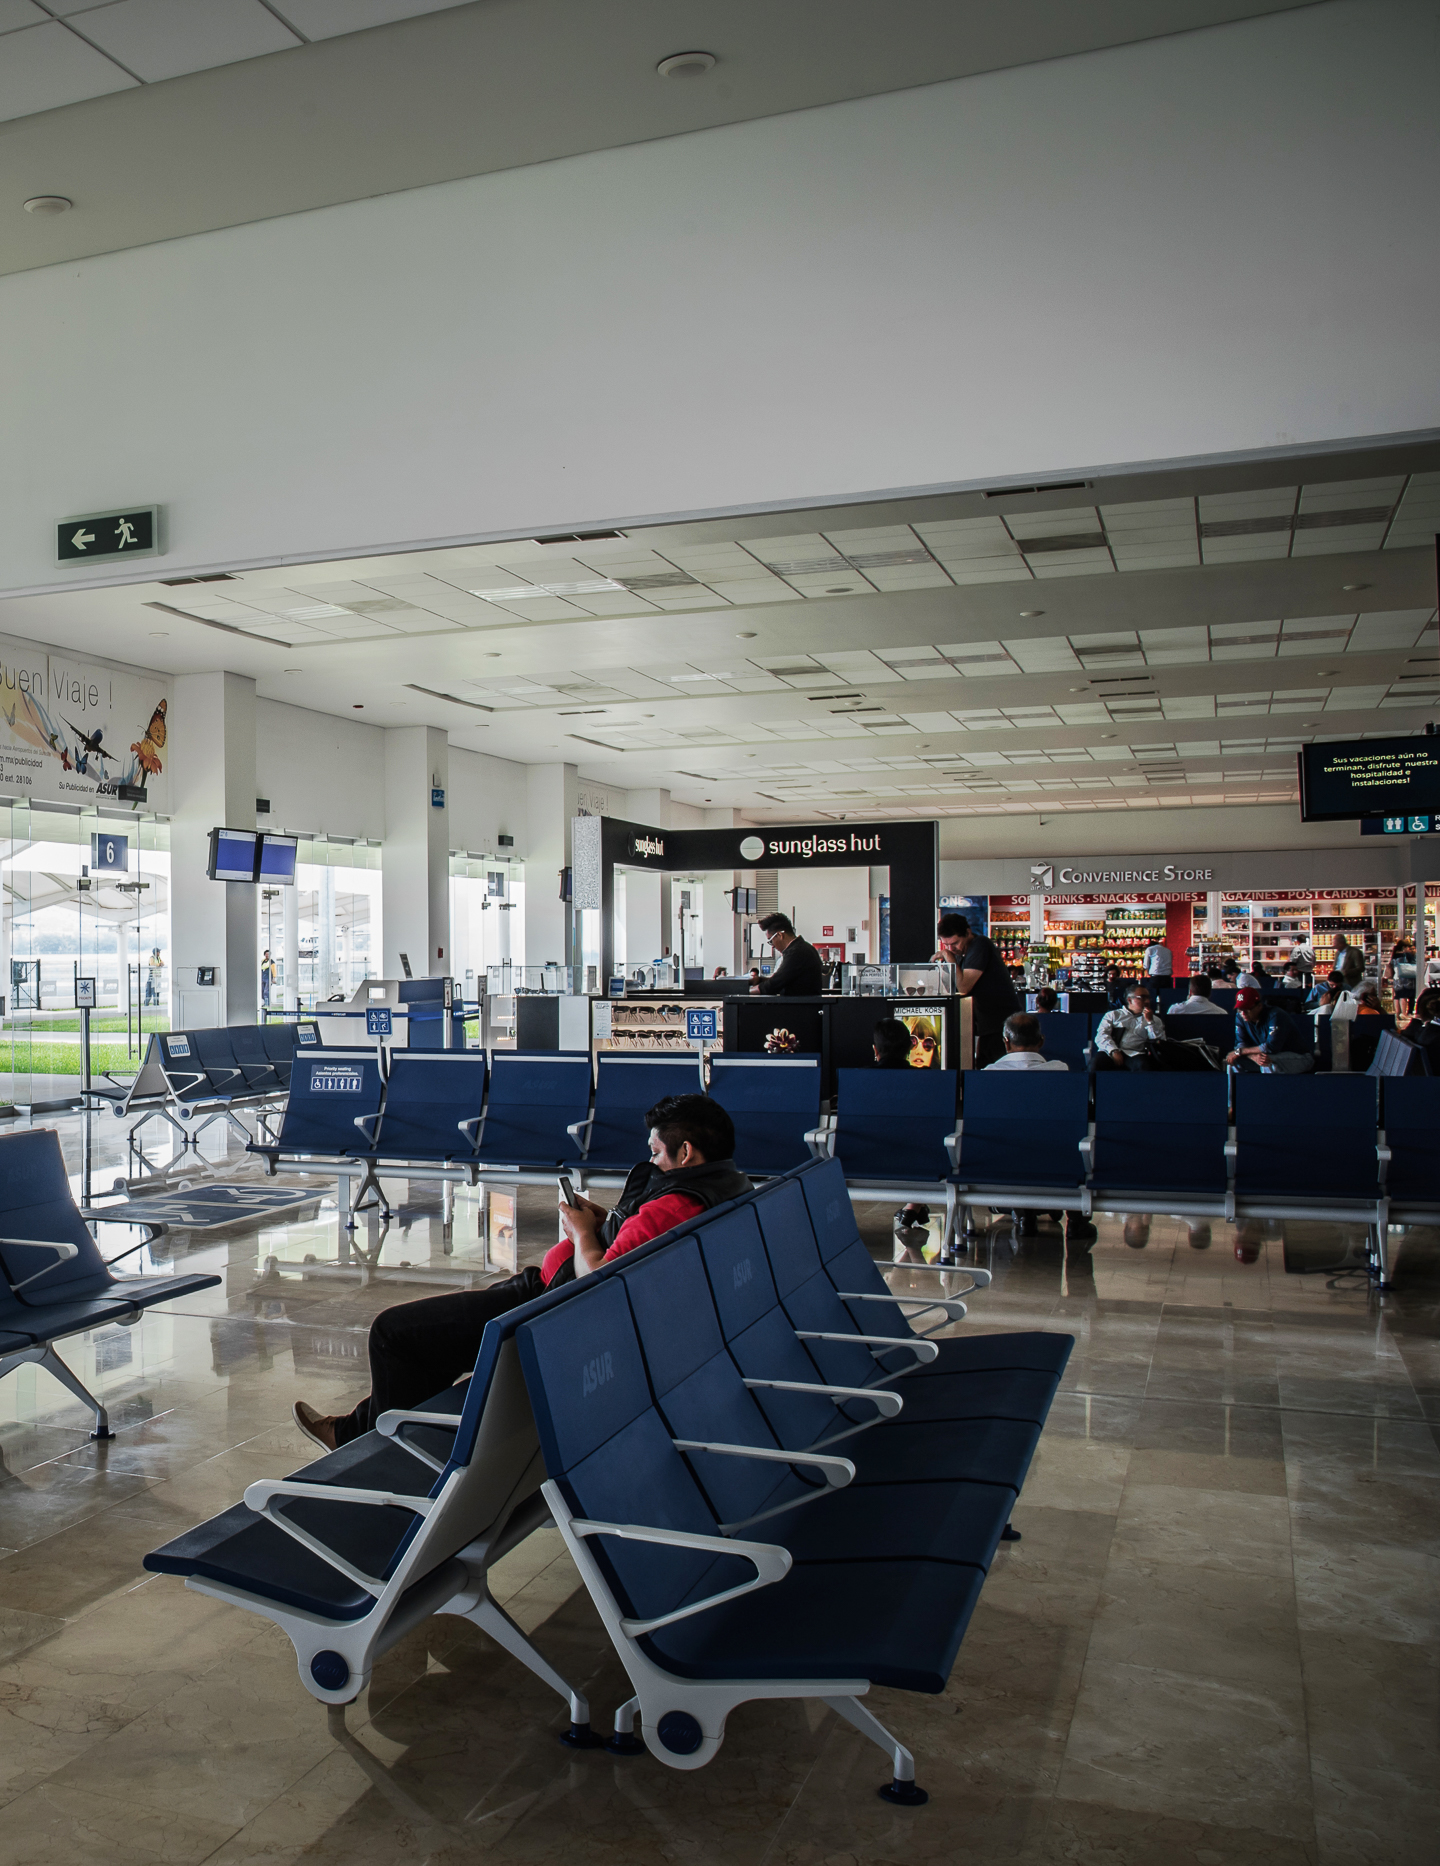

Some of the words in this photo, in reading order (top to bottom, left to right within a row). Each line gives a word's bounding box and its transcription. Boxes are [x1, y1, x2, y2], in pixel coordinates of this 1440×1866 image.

[52, 667, 99, 712] Viaje
[1323, 765, 1365, 773] terminan,
[1367, 761, 1401, 770] disfrute
[1405, 759, 1439, 767] nuestra
[1349, 754, 1396, 763] vacaciones
[1398, 752, 1414, 760] aún
[1350, 769, 1404, 779] hospitalidad
[1351, 777, 1411, 787] instalaciones!
[58, 781, 65, 790] Su
[65, 782, 89, 793] Publicidad
[96, 782, 118, 796] ASUR
[106, 841, 115, 864] 6
[635, 835, 656, 858] sunglass
[656, 837, 664, 856] hut
[768, 834, 847, 858] sunglass
[850, 833, 882, 852] hut
[1060, 867, 1159, 884] CONVENIENCE
[1164, 865, 1212, 881] STORE
[1044, 894, 1085, 904] DRINKS
[1093, 893, 1138, 903] SNACKS
[1146, 892, 1198, 902] CANDIES
[1221, 891, 1279, 901] AGAZINES
[1287, 890, 1321, 900] POST
[1323, 889, 1366, 899] CARDS
[732, 1257, 753, 1291] ASUR
[582, 1350, 615, 1399] ASUR
